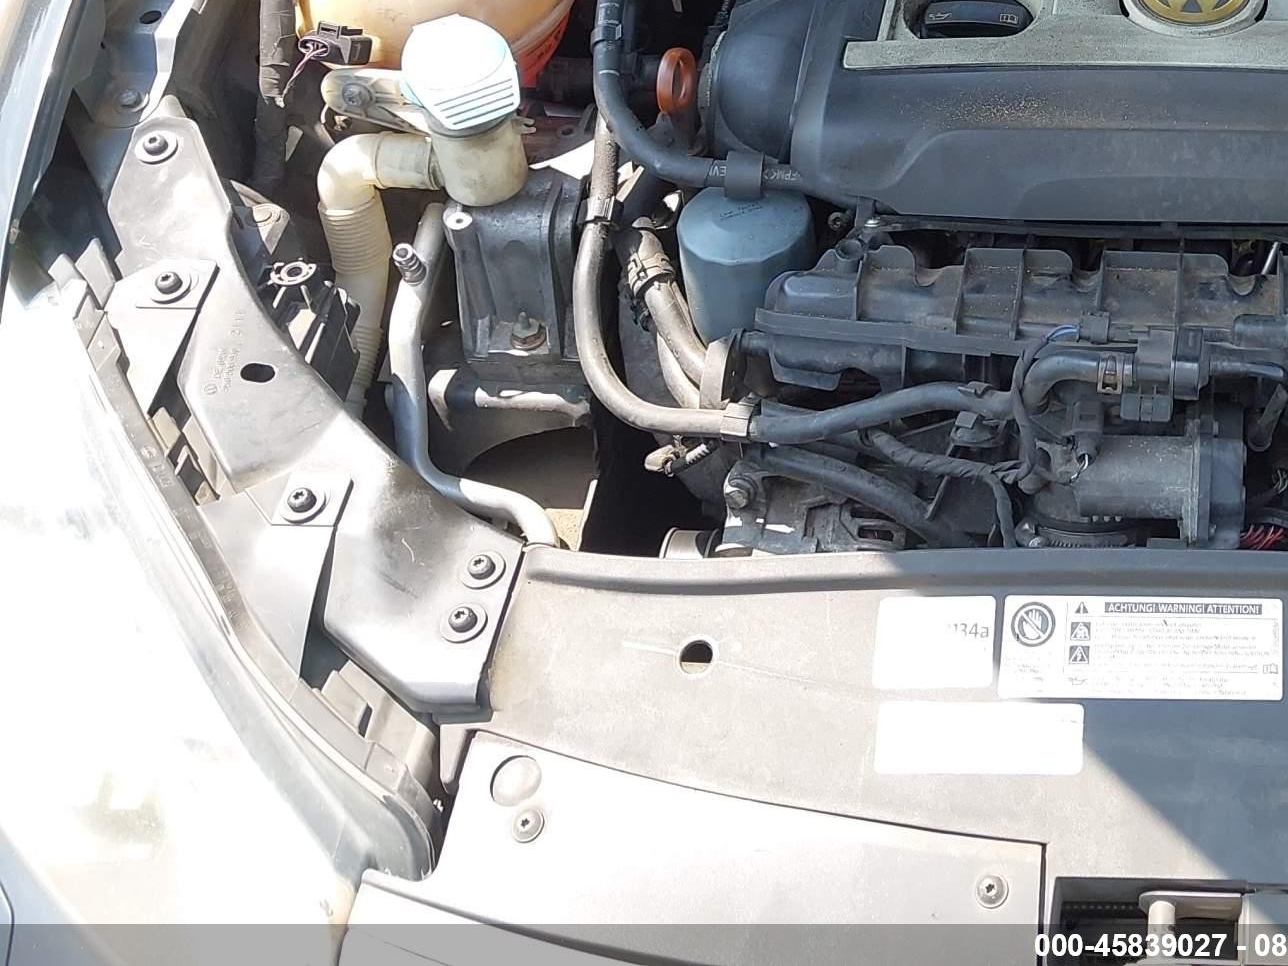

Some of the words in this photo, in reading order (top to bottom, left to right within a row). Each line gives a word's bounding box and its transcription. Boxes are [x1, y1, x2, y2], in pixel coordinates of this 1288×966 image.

[1109, 603, 1156, 613] ACHTUNG!
[1158, 604, 1204, 614] WARNING!
[1206, 604, 1259, 615] ATTENTION!
